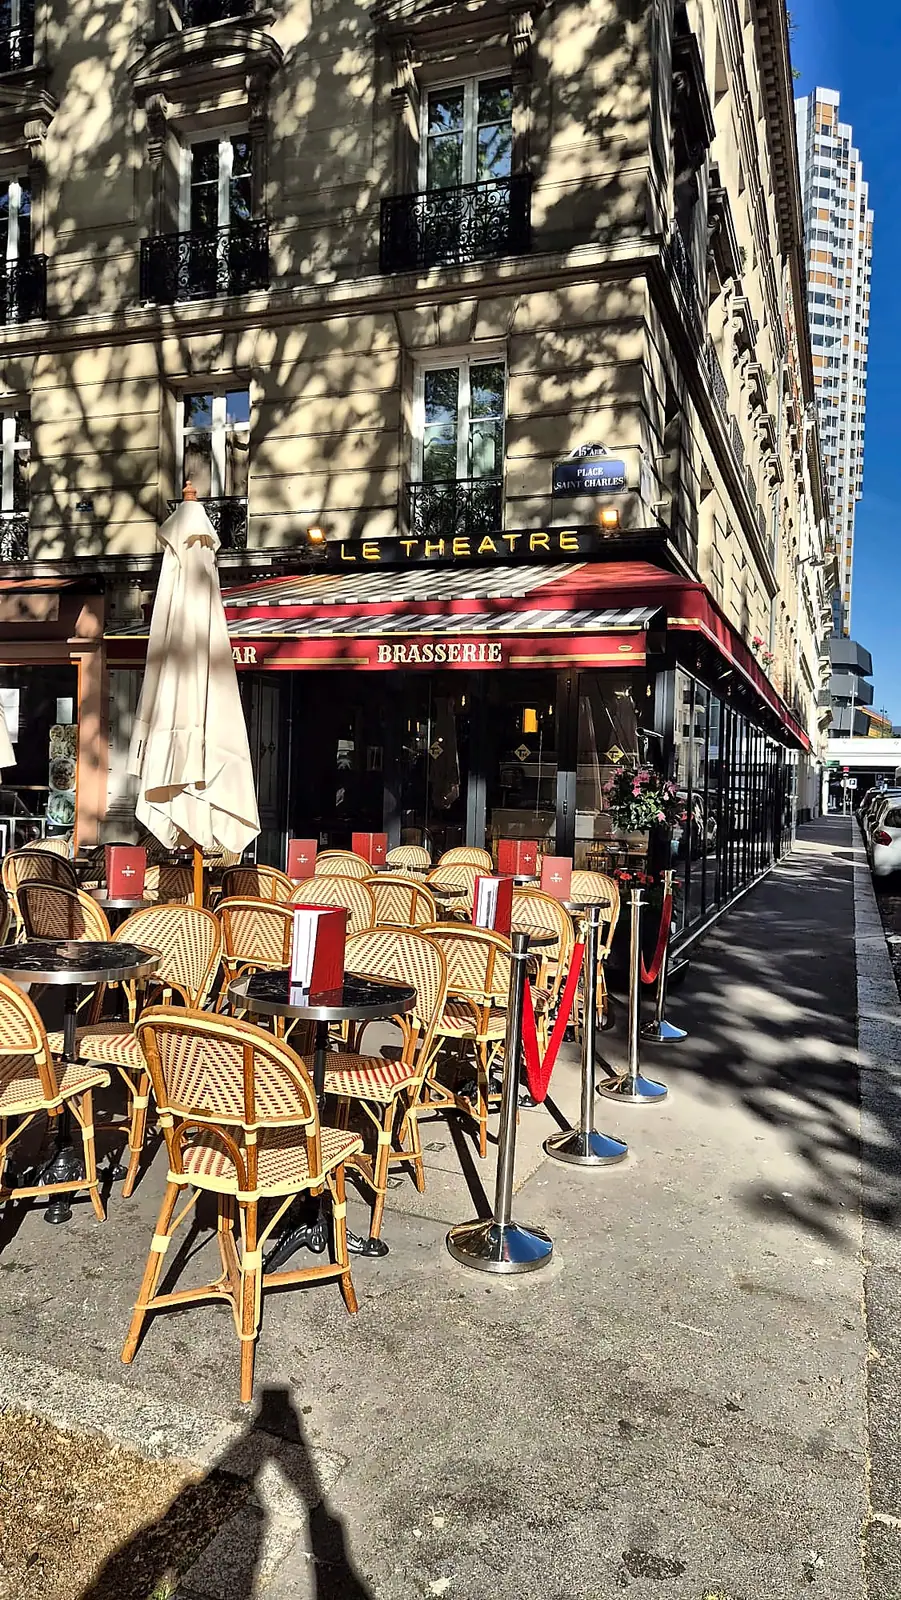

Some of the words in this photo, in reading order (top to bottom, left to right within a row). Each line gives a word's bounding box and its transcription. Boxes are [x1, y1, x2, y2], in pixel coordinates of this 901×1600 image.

[577, 467, 604, 477] PLACE
[556, 480, 581, 489] SAINT
[584, 477, 624, 487] CHARLES
[340, 541, 381, 561] LE
[400, 530, 580, 557] THEATRE
[232, 646, 258, 664] AR
[377, 642, 502, 663] BRASSERIE
